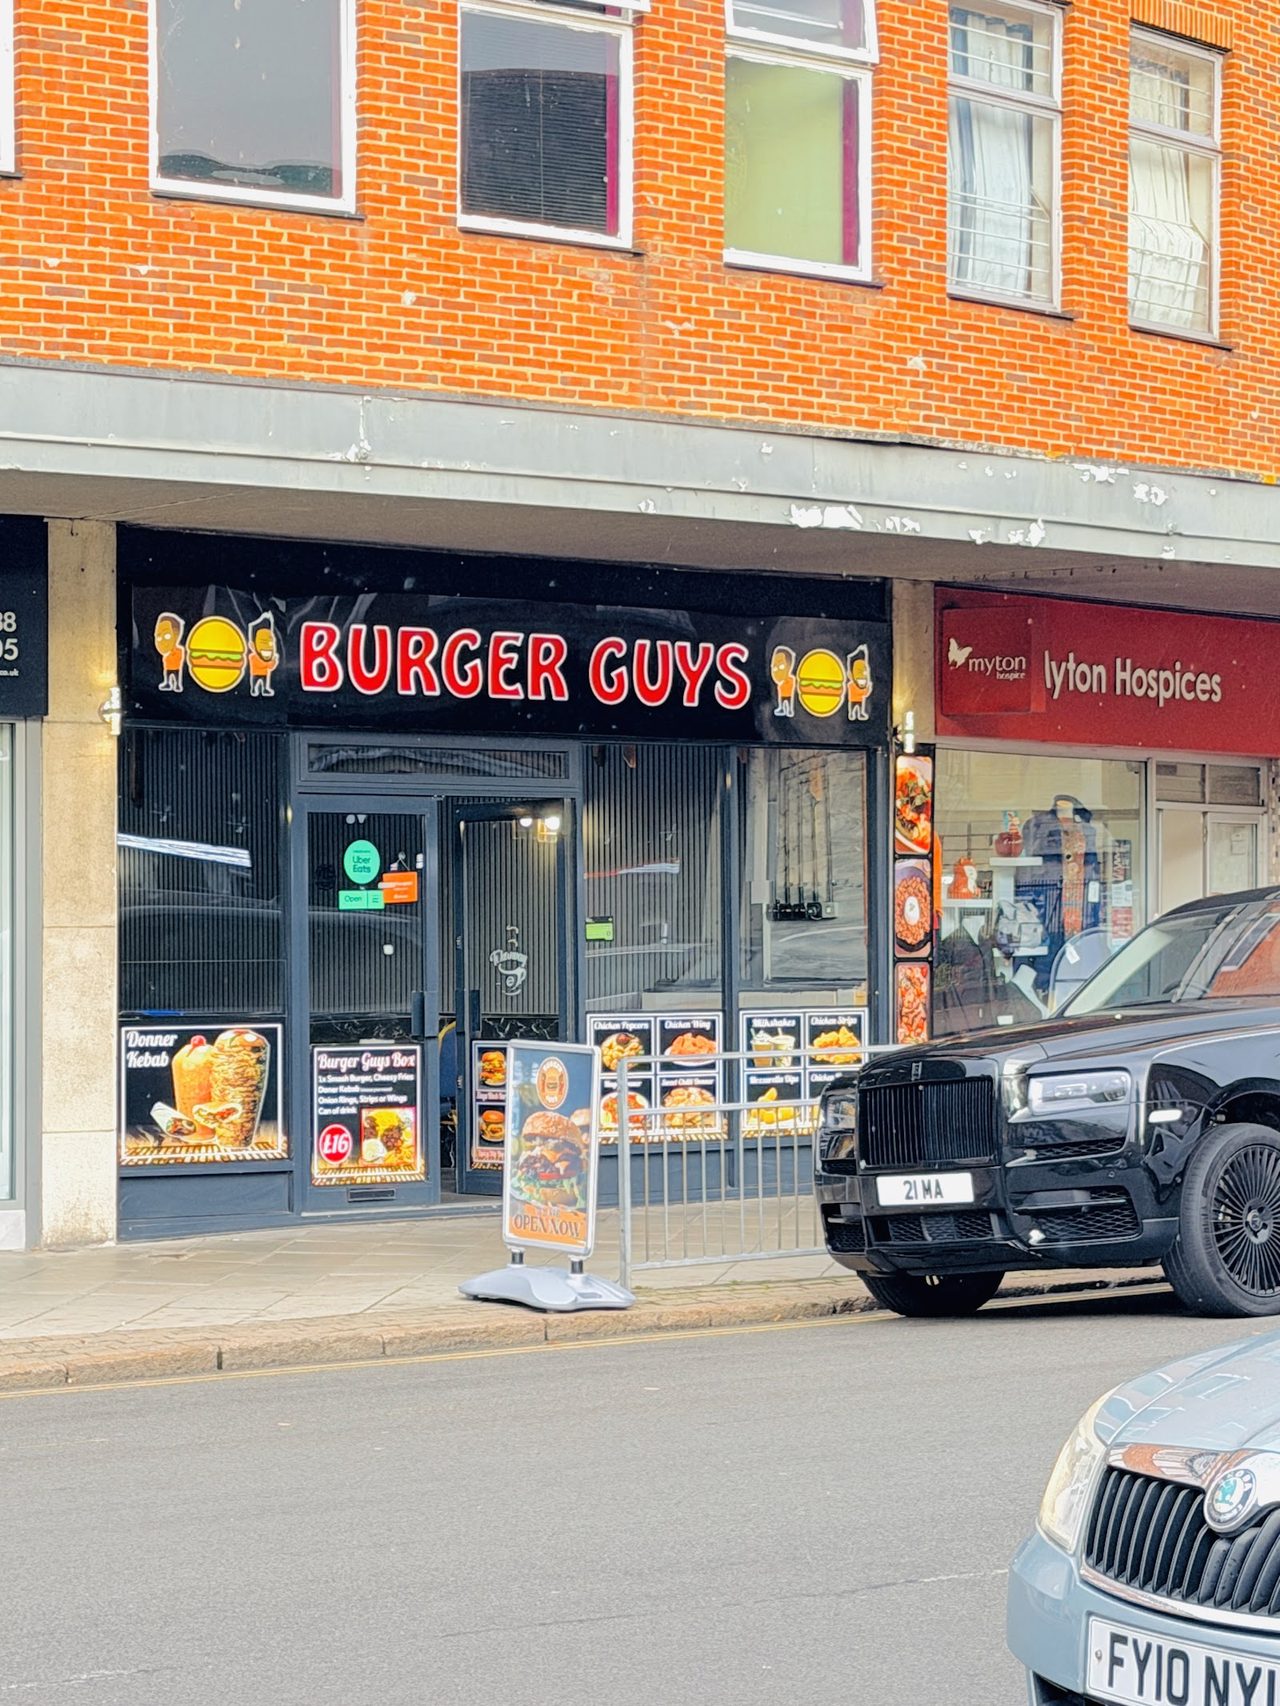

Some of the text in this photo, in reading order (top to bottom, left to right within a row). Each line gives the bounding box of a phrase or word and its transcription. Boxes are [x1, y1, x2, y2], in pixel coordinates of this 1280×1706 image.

[0, 611, 17, 632] 8
[0, 638, 19, 661] 5
[299, 621, 751, 710] BURGER GUYS
[968, 655, 1027, 676] myton
[1115, 657, 1222, 708] Hospices
[352, 855, 372, 864] Uber
[352, 864, 372, 874] Eats
[344, 894, 363, 903] Open
[594, 1021, 649, 1032] Chicken Popcorn
[664, 1020, 691, 1030] Chicken
[810, 1016, 837, 1026] Chicken
[126, 1031, 178, 1048] Donner
[126, 1050, 170, 1068] Kebab
[318, 1051, 416, 1073] Burger Guys Box
[397, 1072, 415, 1081] Fries
[318, 1096, 338, 1104] Onion
[318, 1107, 331, 1115] Can
[323, 1133, 350, 1154] £16
[903, 1179, 944, 1200] 21 MA
[513, 1213, 579, 1238] OPEN NOW
[1108, 1631, 1189, 1705] FY10
